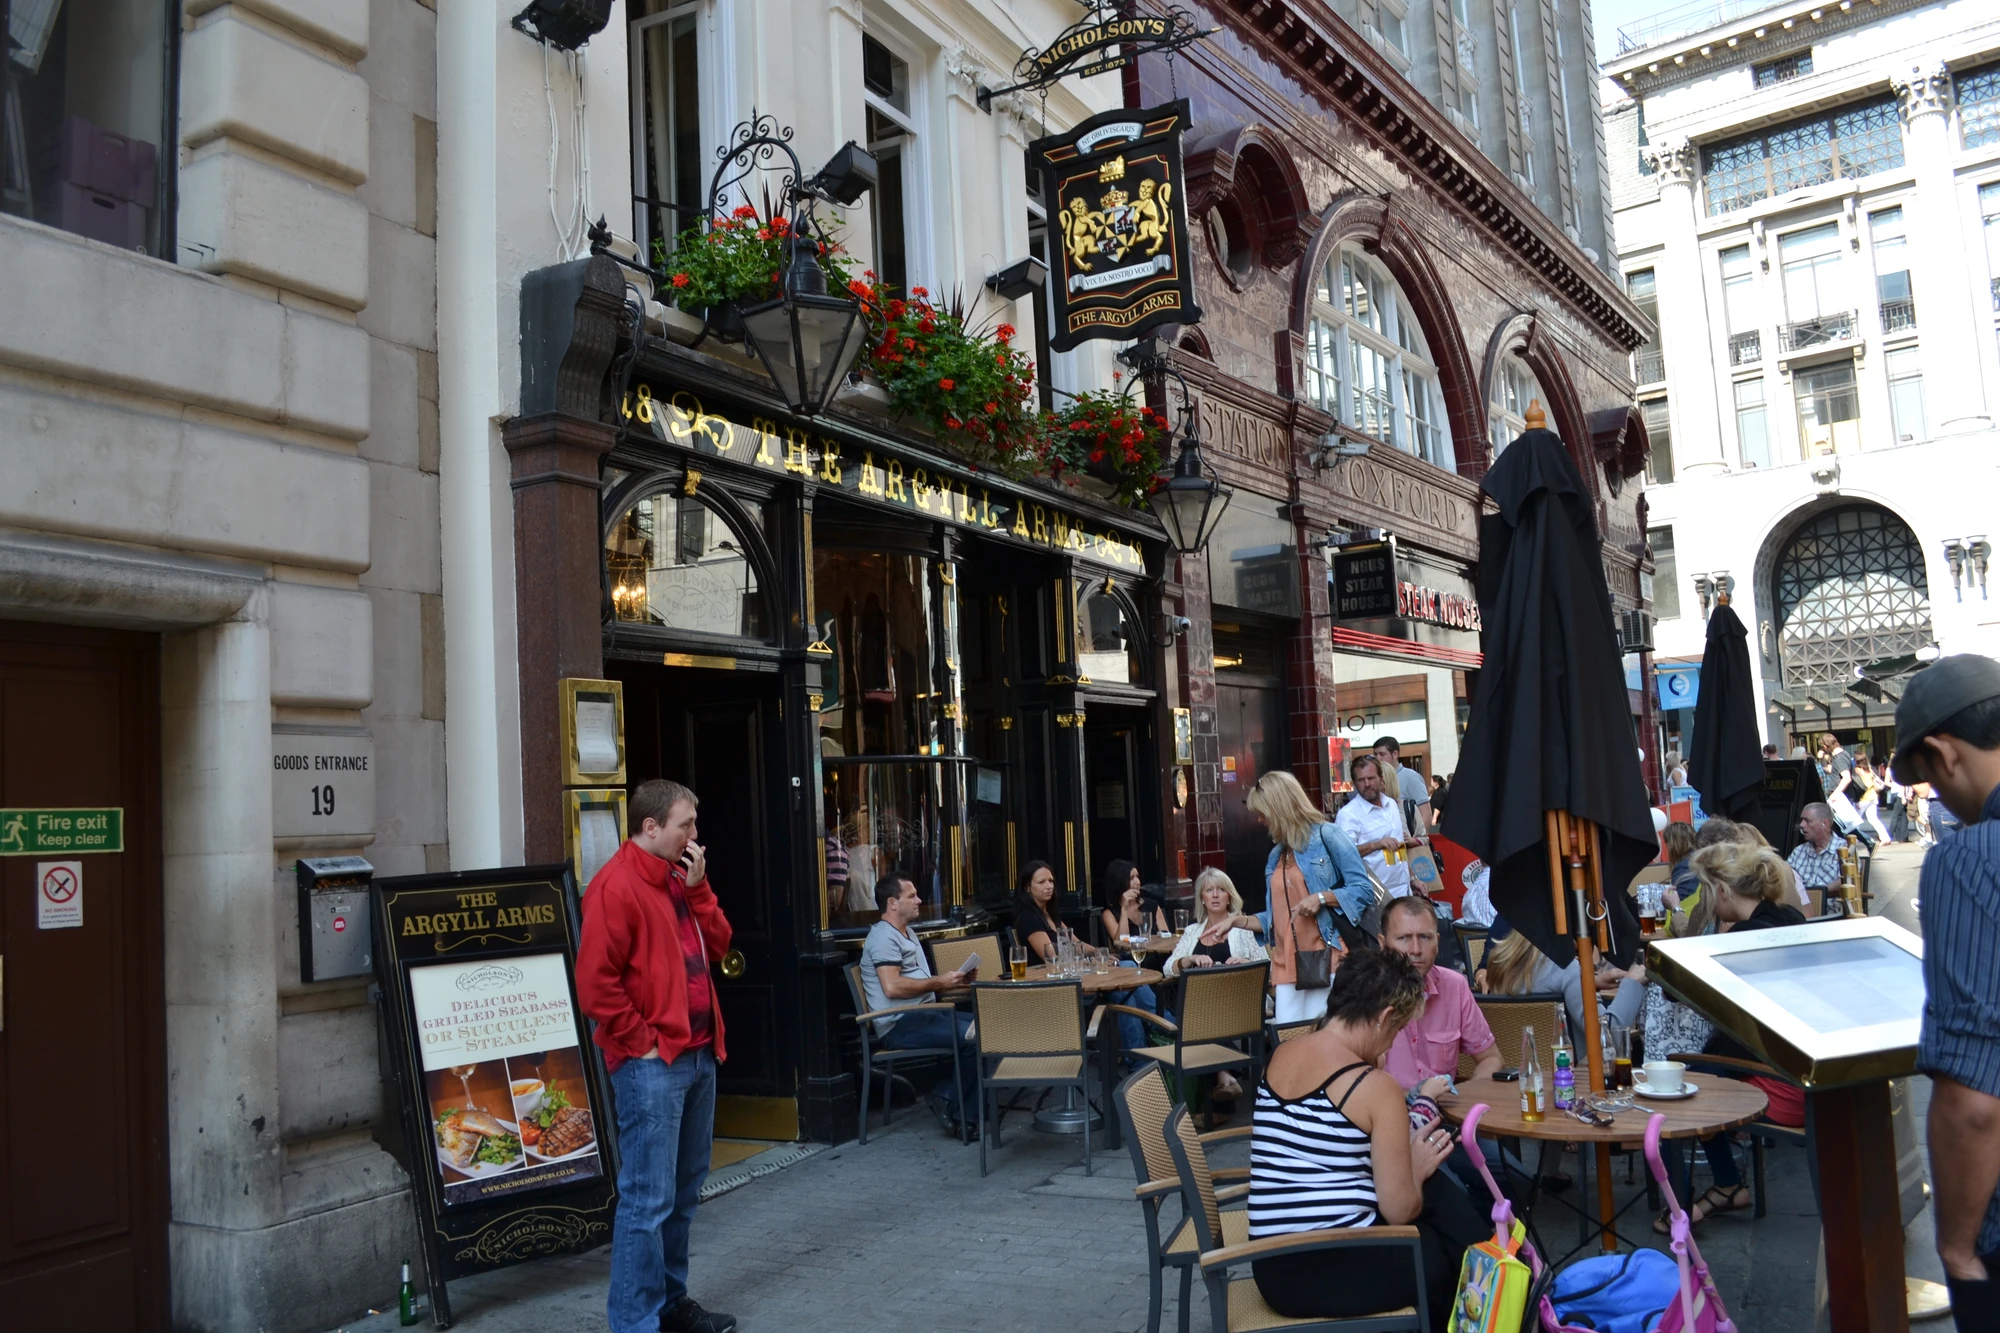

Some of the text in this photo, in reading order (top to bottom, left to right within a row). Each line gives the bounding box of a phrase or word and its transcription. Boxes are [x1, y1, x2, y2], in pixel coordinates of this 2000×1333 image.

[1038, 19, 1165, 70] NICHOLSON'S
[1084, 58, 1126, 76] EST. 1873
[1081, 136, 1092, 146] NE
[1085, 278, 1097, 287] VIX
[1108, 269, 1133, 281] NOSTRO
[1134, 265, 1152, 275] VOCO
[1073, 294, 1175, 326] THE ARGYLL ARMS
[1202, 402, 1289, 471] STATION
[753, 414, 842, 485] THE
[859, 451, 998, 528] ARGYLL
[1013, 500, 1087, 552] ARMS
[1350, 455, 1458, 531] OXFORD
[1344, 557, 1385, 575] NGUS
[1345, 576, 1385, 593] STEAK
[661, 593, 709, 612] FREE HOUSE
[1398, 581, 1438, 622] STEAK
[274, 755, 368, 771] GOODS ENTRANCE
[1768, 779, 1794, 790] ARMS
[311, 785, 335, 816] 19
[37, 814, 108, 830] Fire exit
[37, 833, 107, 847] Keep clear
[456, 892, 498, 908] THE
[402, 904, 556, 936] ARGYLL ARMS
[466, 970, 514, 985] NICHOLSON'S
[450, 991, 538, 1012] DELICIOUS
[422, 999, 568, 1030] GRILLED SEABASS
[425, 1011, 570, 1045] OR SUCCULENT
[466, 1029, 537, 1052] STEAK?
[481, 1167, 577, 1194] WWW.NICHOLSONSPUBS.CO.UK
[494, 1224, 573, 1252] NICHOLSON'S
